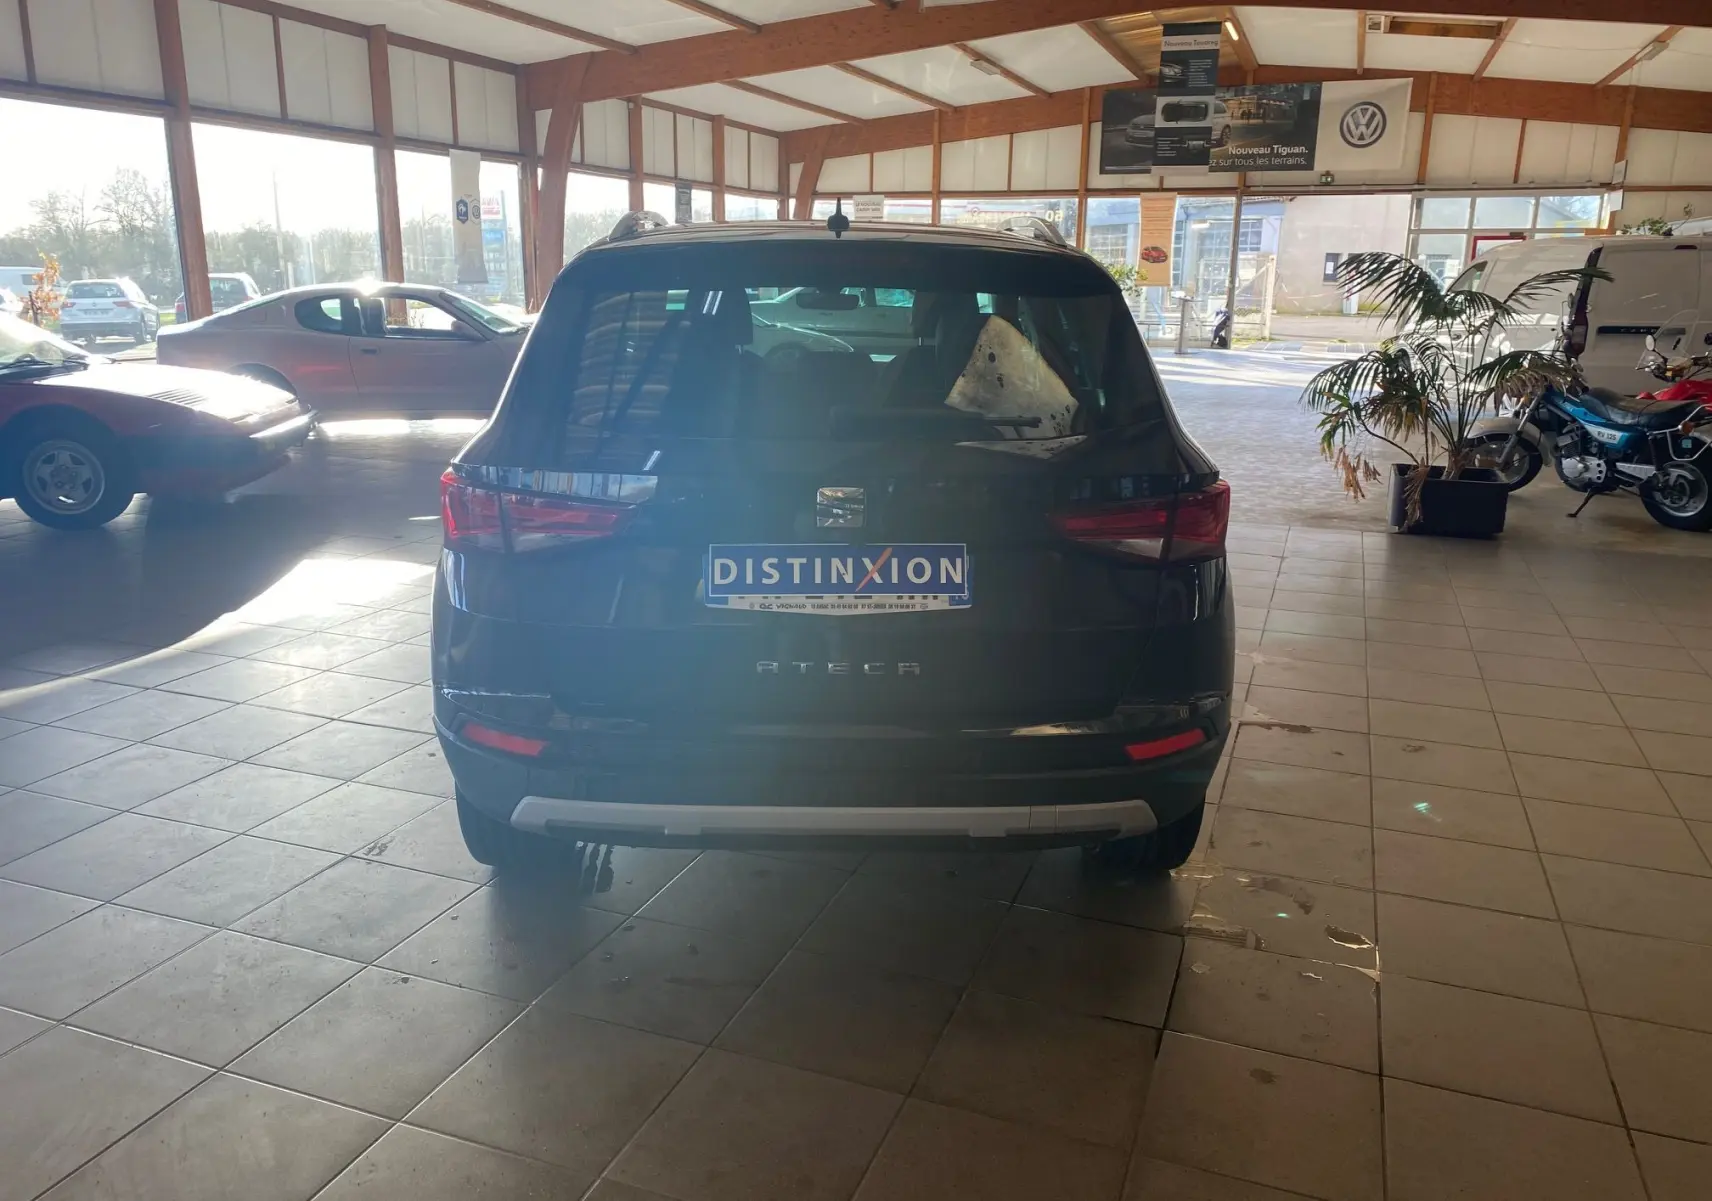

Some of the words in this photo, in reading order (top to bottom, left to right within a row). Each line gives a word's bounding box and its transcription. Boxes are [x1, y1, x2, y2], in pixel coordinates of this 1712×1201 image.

[1229, 146, 1271, 155] Nouveau
[1272, 145, 1309, 155] Tiguan.
[1234, 158, 1254, 166] tous
[1256, 156, 1269, 165] les
[1271, 156, 1307, 165] terrains.
[1606, 432, 1617, 441] 125
[756, 661, 920, 675] ATECA
